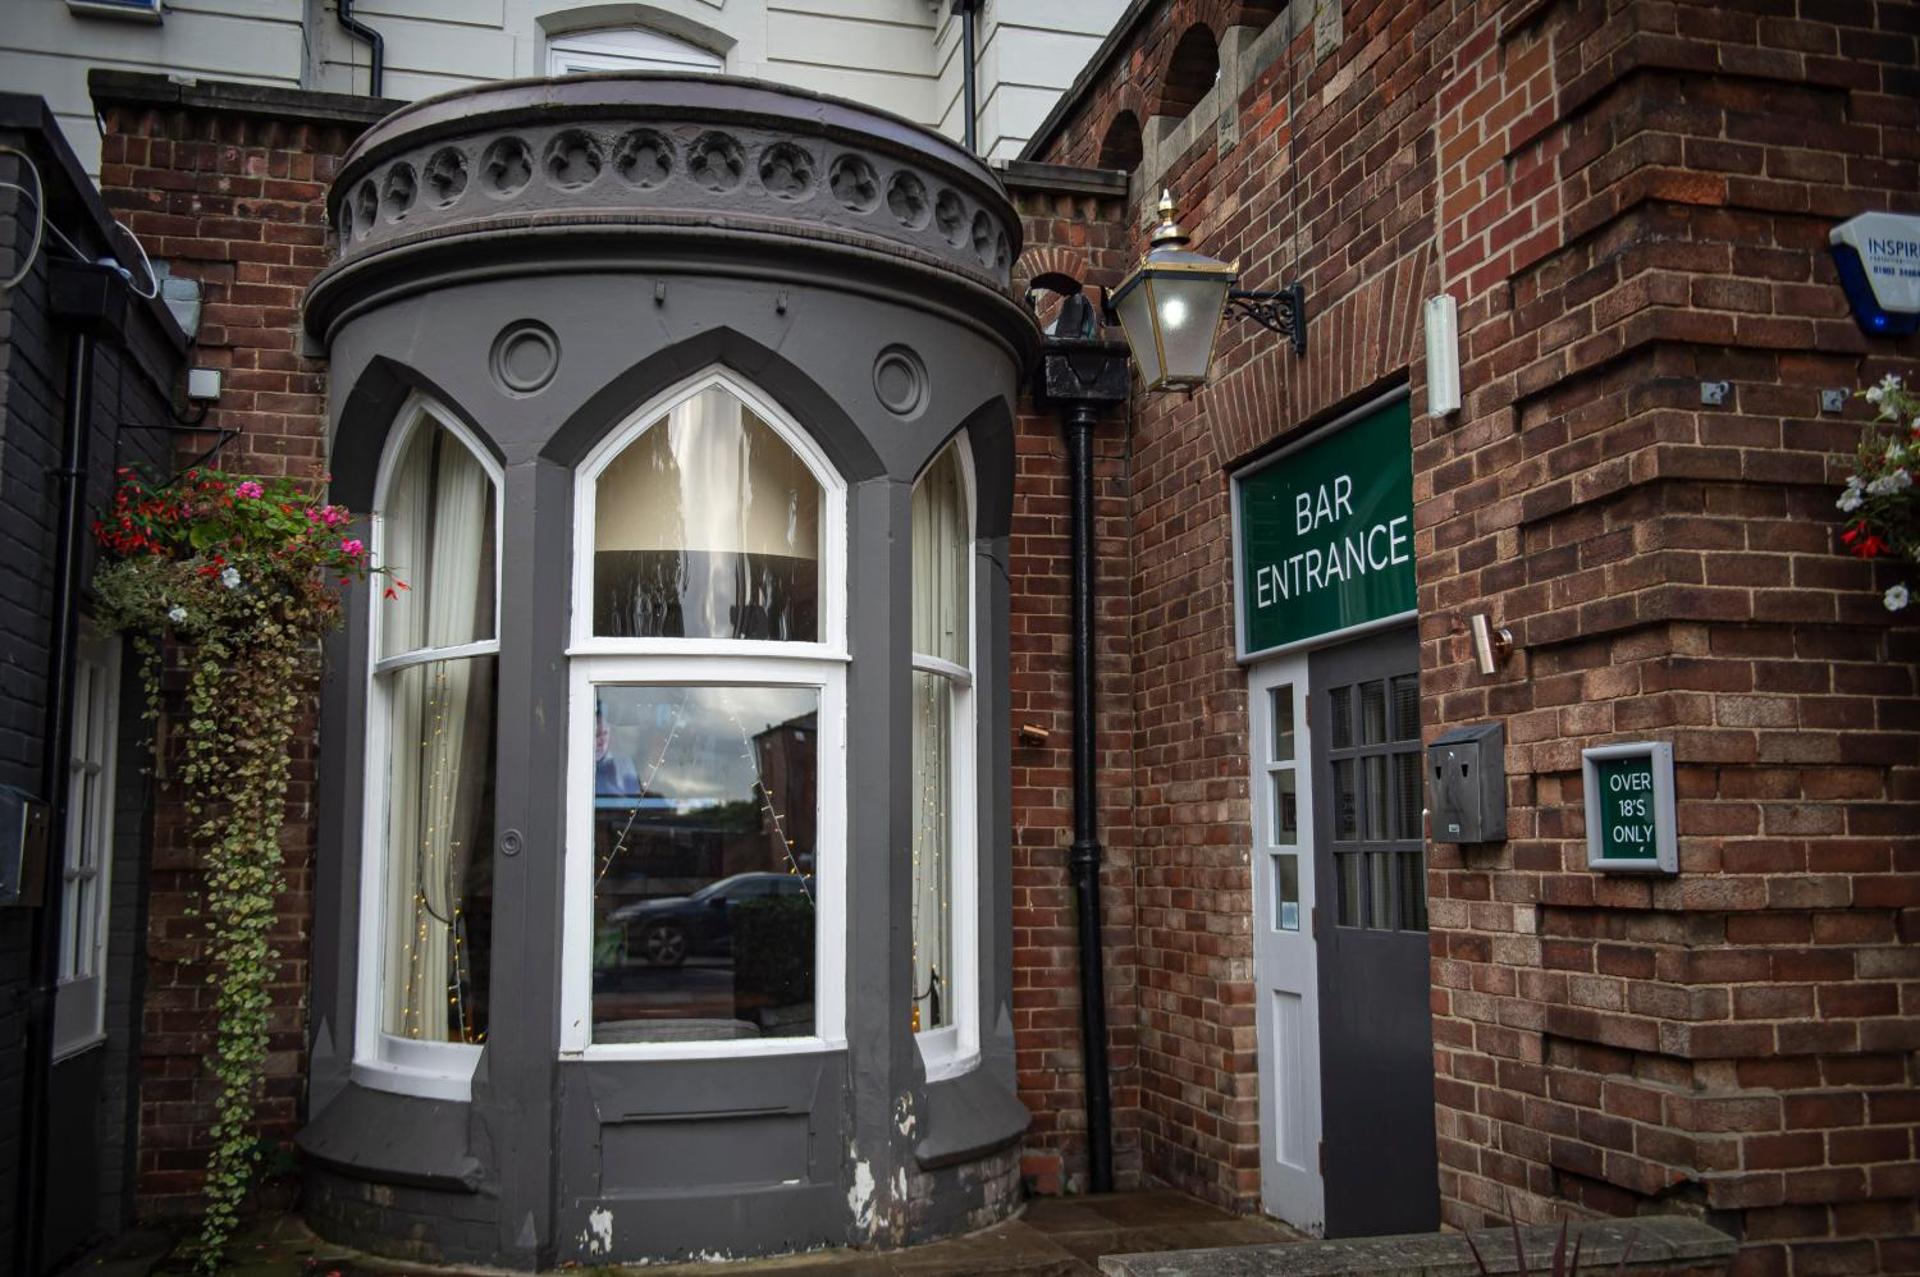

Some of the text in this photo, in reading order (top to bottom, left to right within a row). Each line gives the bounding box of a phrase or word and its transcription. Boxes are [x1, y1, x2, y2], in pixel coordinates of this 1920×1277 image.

[1869, 238, 1920, 258] INSPIR
[1295, 474, 1353, 536] BAR
[1257, 515, 1409, 609] ENTRANCE
[1609, 772, 1652, 791] OVER
[1618, 799, 1646, 817] 18'S
[1613, 824, 1653, 842] ONLY
